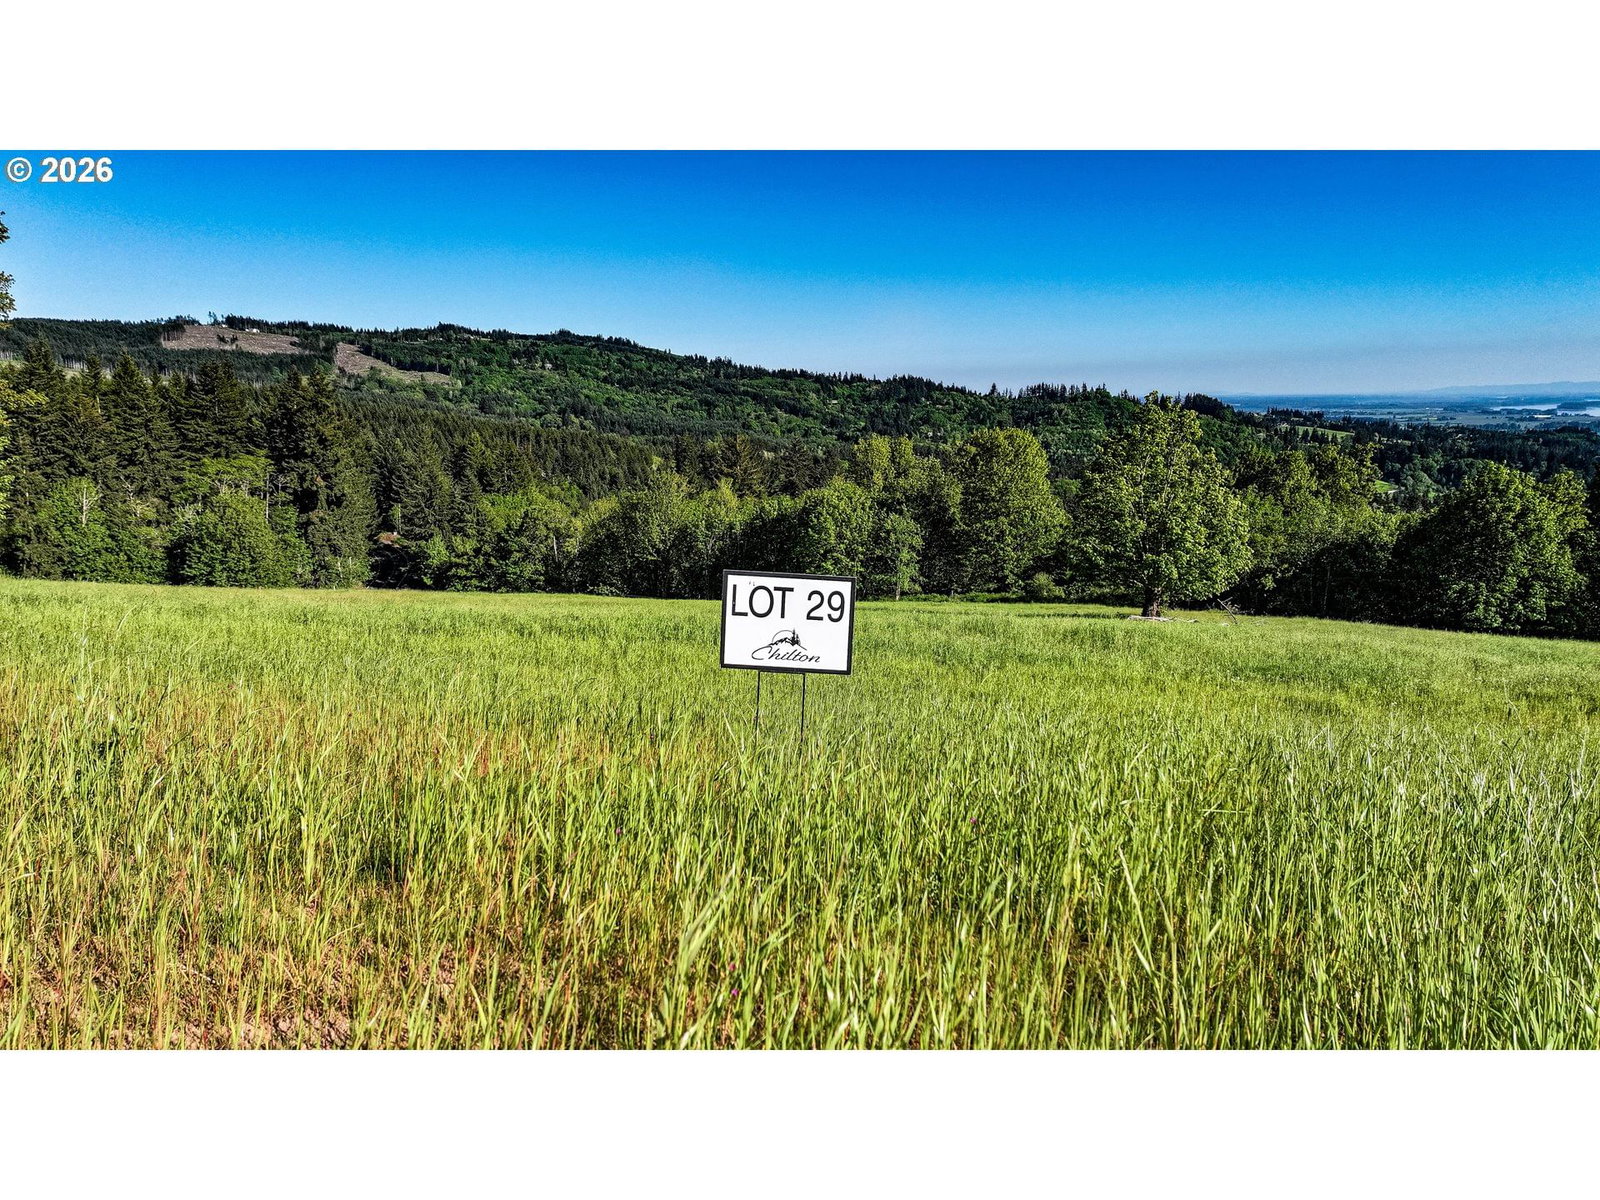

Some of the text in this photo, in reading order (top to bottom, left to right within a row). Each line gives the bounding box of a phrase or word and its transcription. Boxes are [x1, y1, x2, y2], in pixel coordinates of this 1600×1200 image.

[731, 584, 845, 622] LOT 29
[751, 645, 822, 663] Chilton
